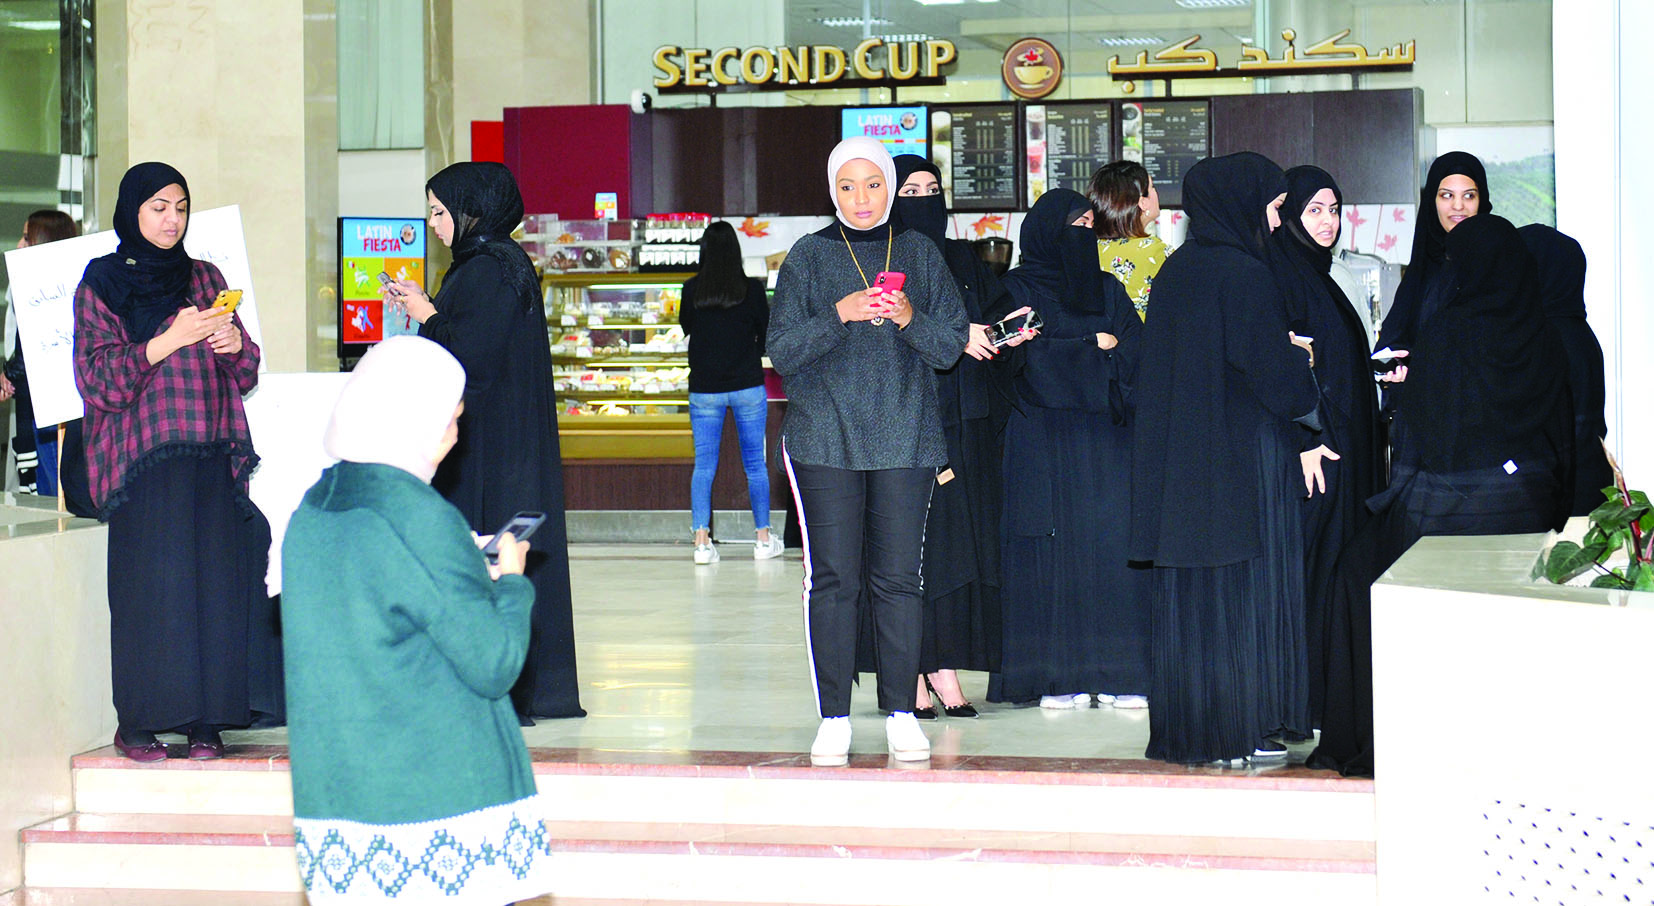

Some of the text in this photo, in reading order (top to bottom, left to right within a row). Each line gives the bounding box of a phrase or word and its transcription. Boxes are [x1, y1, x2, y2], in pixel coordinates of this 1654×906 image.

[652, 38, 956, 88] SECOND CUP
[1107, 28, 1415, 94] سكند كب
[858, 114, 893, 127] LATIN
[864, 124, 901, 136] FIESTA
[357, 224, 392, 241] LATIN
[363, 238, 401, 252] FIESTA
